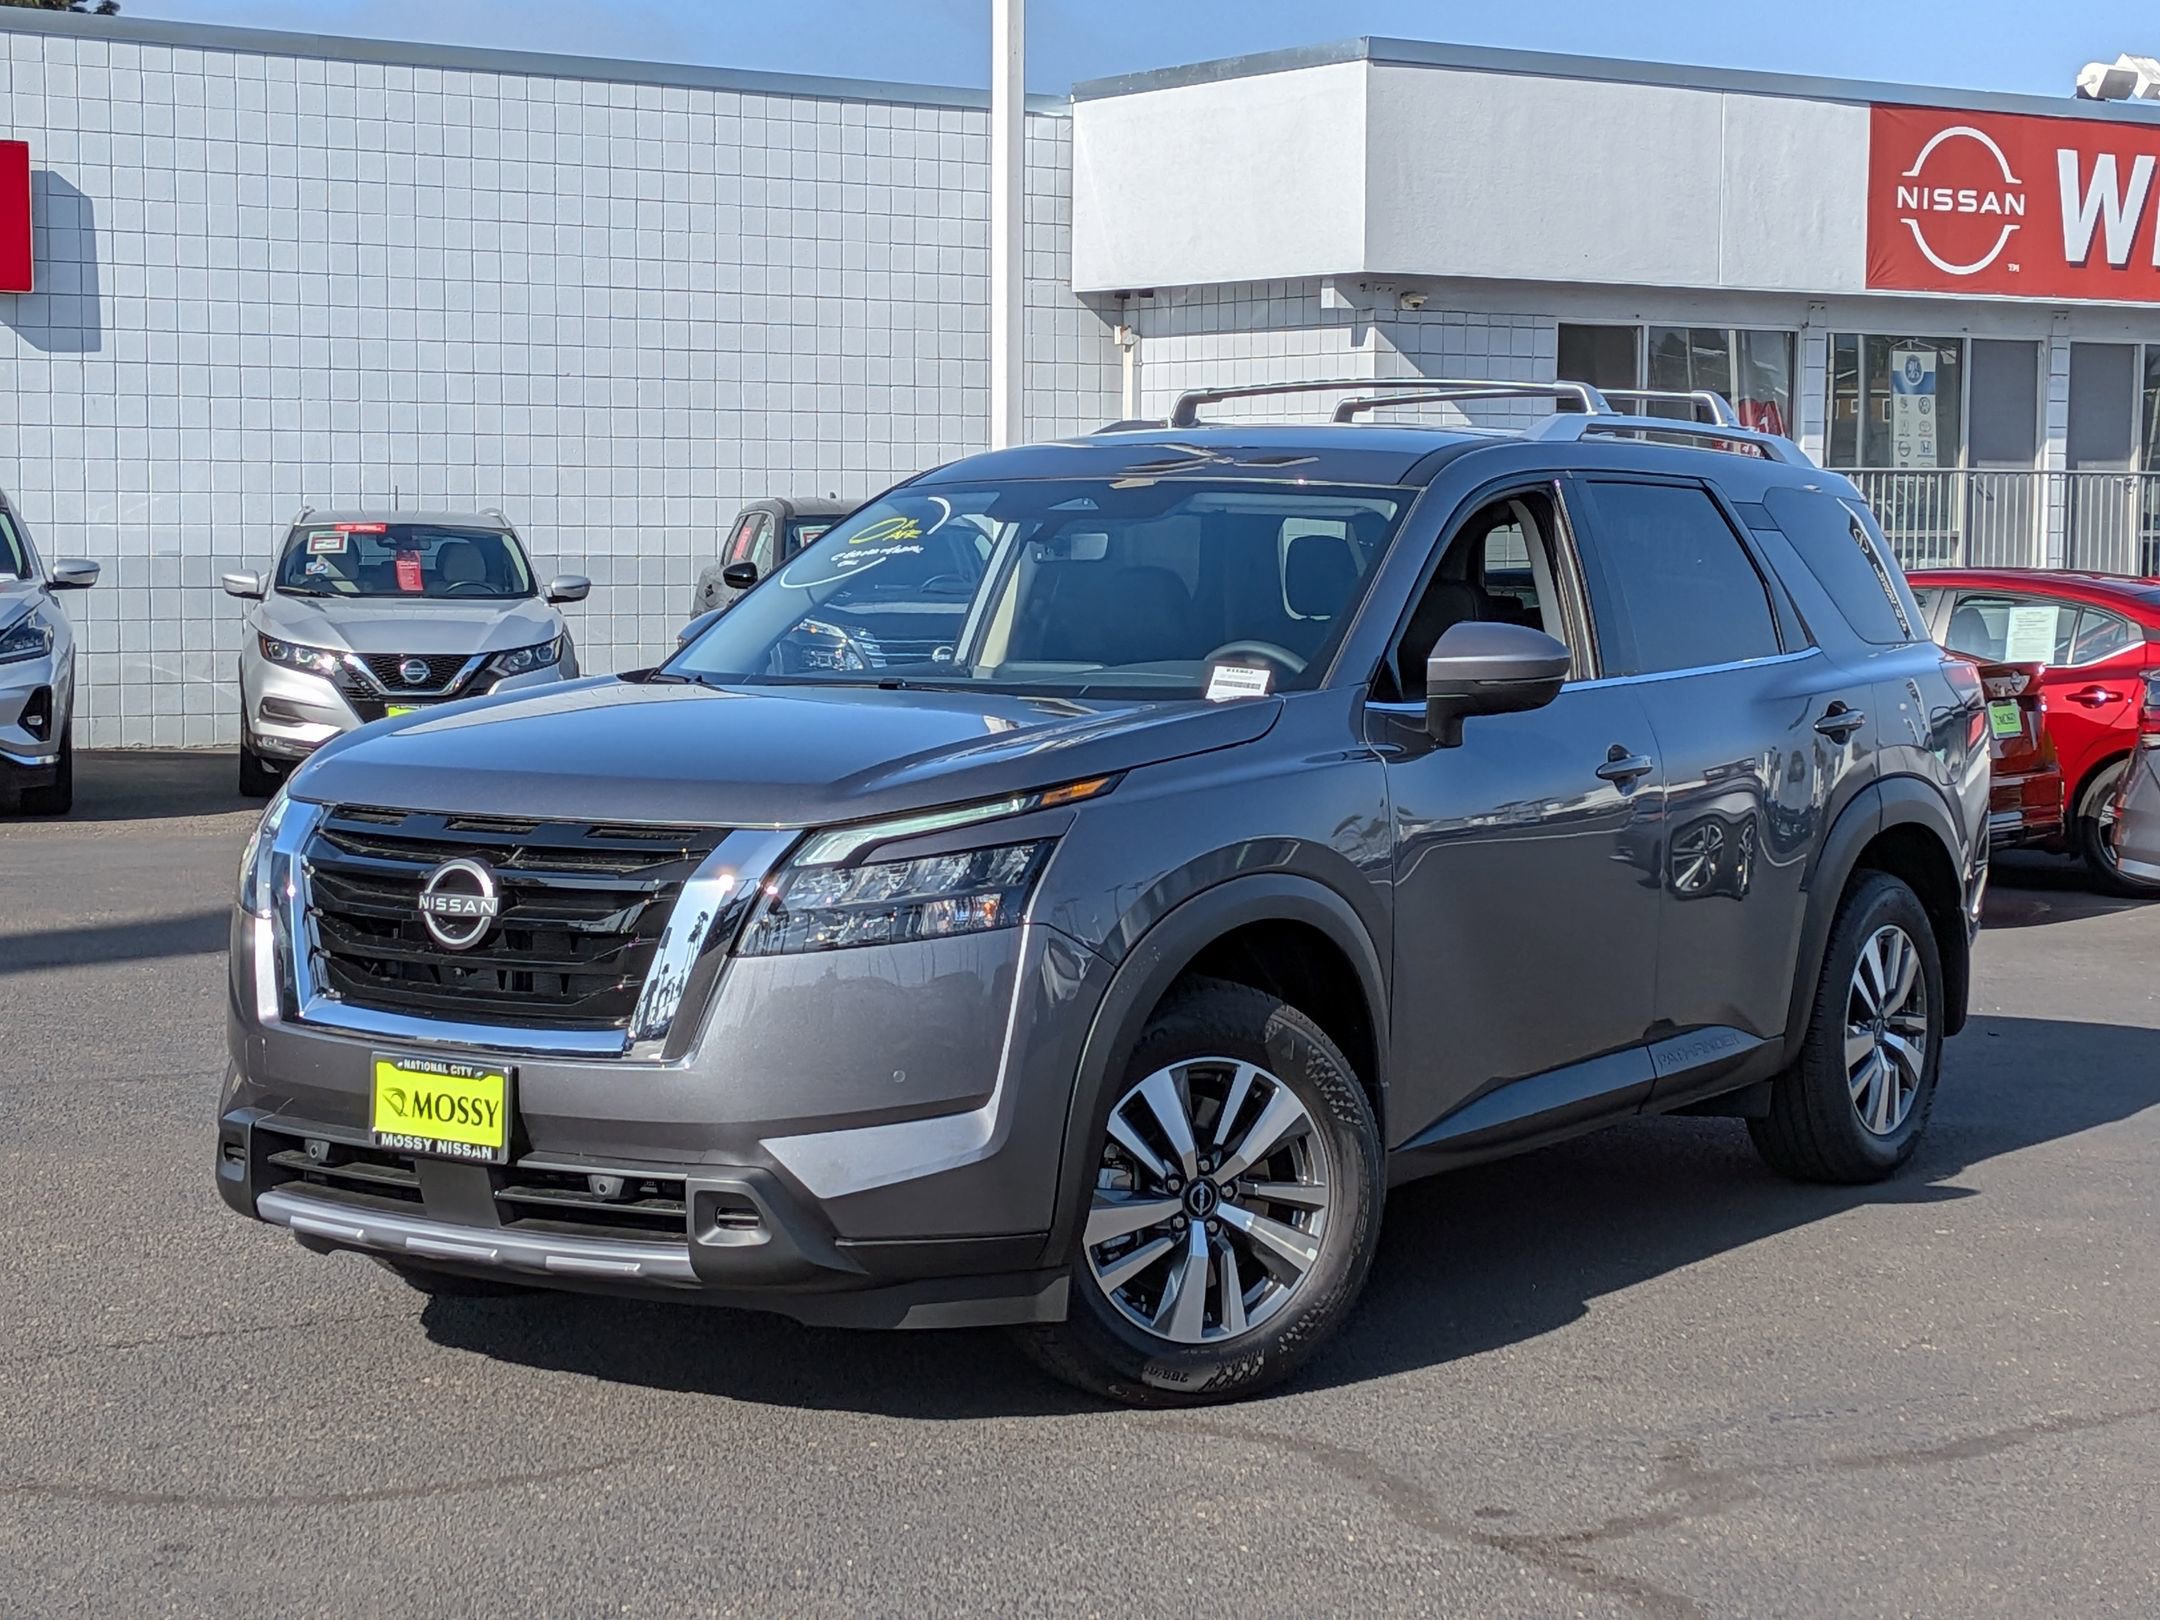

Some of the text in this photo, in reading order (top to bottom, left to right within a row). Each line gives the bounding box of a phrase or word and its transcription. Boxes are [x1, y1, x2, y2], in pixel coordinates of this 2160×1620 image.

[1897, 186, 2025, 216] NISSAN
[2057, 148, 2160, 268] W
[419, 896, 495, 913] NISSAN
[404, 1059, 473, 1077] NATIONAL CITY
[412, 1090, 499, 1128] MOSSY
[381, 1133, 492, 1160] MOSSY NISSAN
